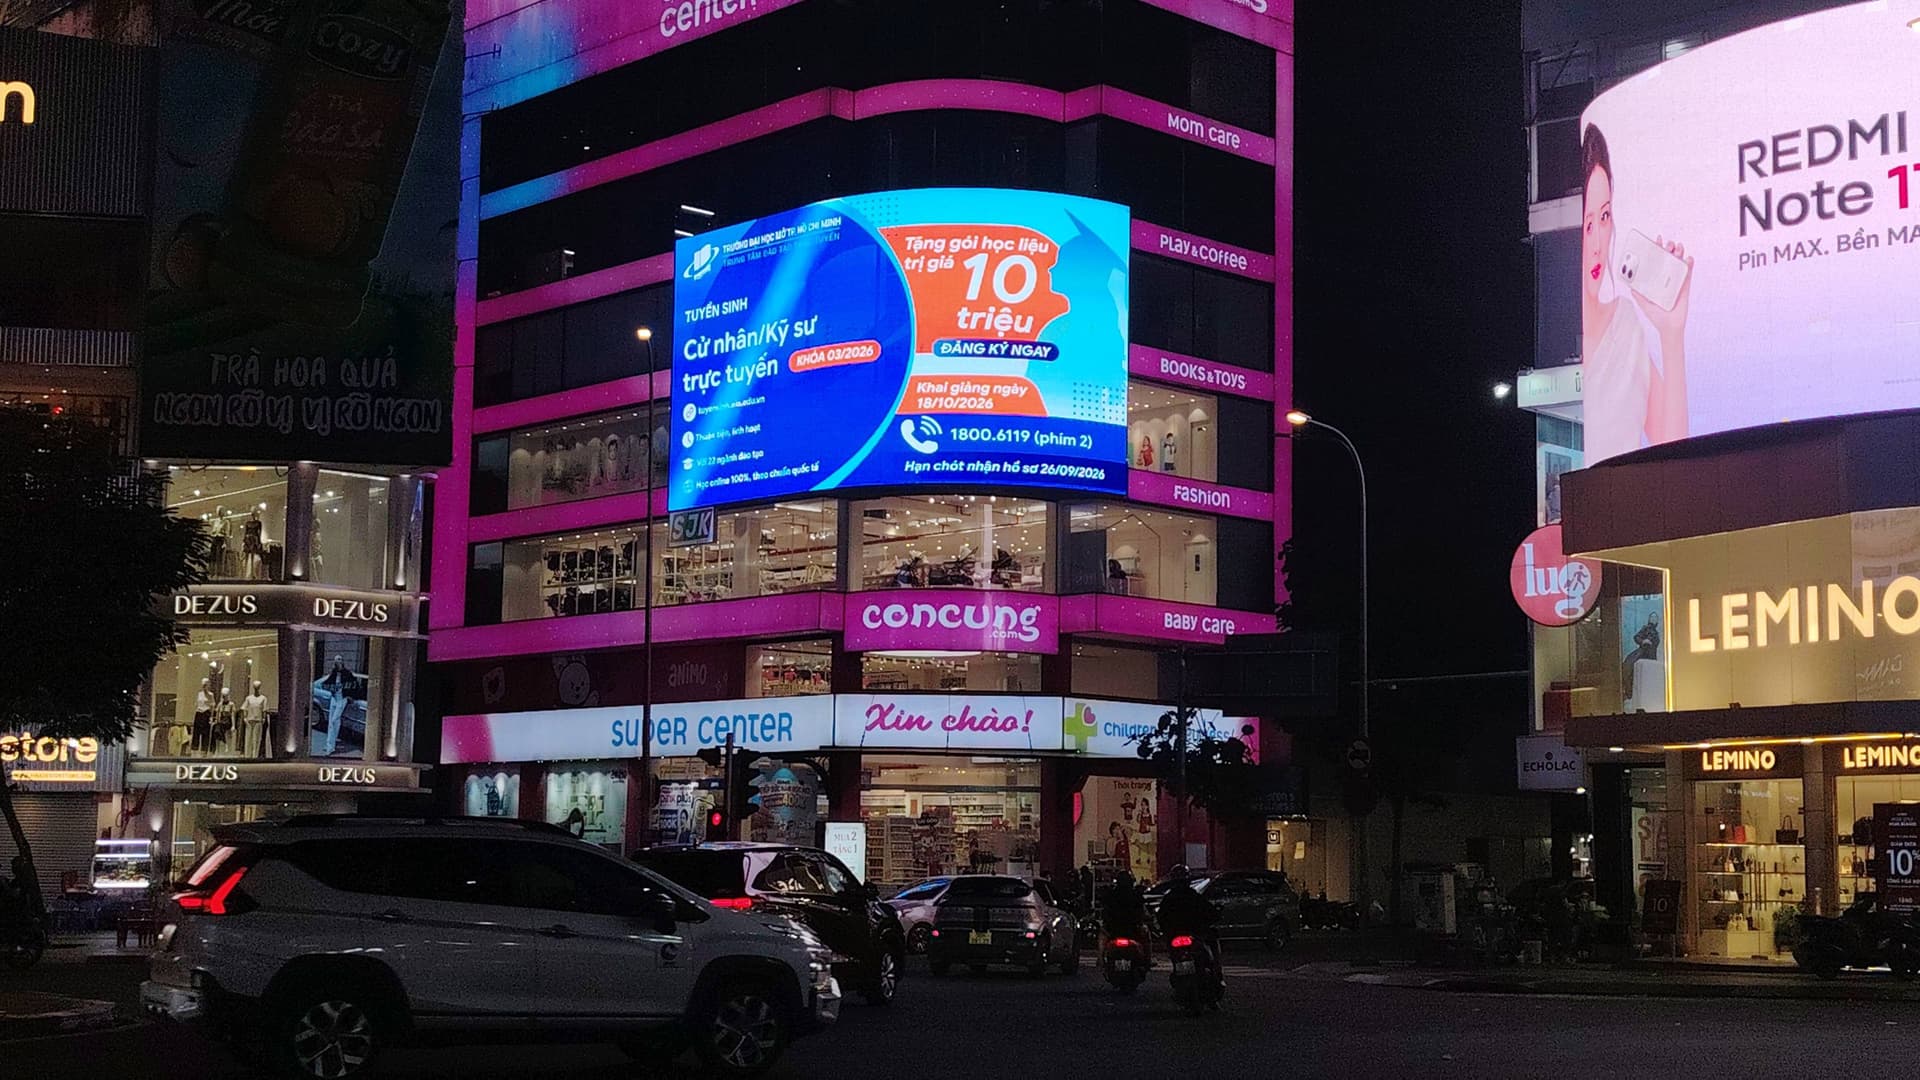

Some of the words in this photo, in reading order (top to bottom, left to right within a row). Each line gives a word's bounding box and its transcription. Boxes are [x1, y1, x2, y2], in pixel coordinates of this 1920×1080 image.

[1167, 112, 1204, 138] Mom
[1208, 125, 1241, 148] care
[1737, 111, 1908, 184] REDMI
[1738, 179, 1874, 237] Note
[1887, 163, 1920, 210] 1
[904, 236, 946, 254] Tặng
[981, 236, 1015, 254] học
[1018, 238, 1050, 256] liệu
[1738, 252, 1767, 271] Pin
[1773, 238, 1829, 265] MAX.
[1836, 227, 1880, 253] Bền
[904, 255, 925, 273] trị
[927, 255, 955, 273] giá
[963, 252, 1038, 304] 10
[721, 296, 749, 315] SINH
[957, 306, 1034, 338] triệu
[683, 335, 711, 361] Cử
[713, 318, 790, 355] nhân/Kỹ
[794, 314, 819, 338] sư
[1011, 344, 1052, 358] NGAY
[209, 346, 261, 386] TRÀ
[273, 355, 328, 388] HOA
[339, 344, 398, 388] QUẢ
[826, 344, 874, 362] 03/2026
[682, 367, 721, 395] trực
[726, 352, 778, 386] tuyến
[916, 381, 947, 394] Khai
[950, 383, 992, 397] giảng
[993, 384, 1029, 398] ngày
[917, 397, 994, 410] 18/10/2026
[950, 428, 1031, 443] 1800.6119
[1034, 430, 1077, 447] (phím
[1079, 434, 1093, 449] 2)
[904, 460, 931, 474] Hạn
[932, 460, 965, 473] chót
[966, 460, 1001, 474] nhận
[1002, 460, 1021, 473] hồ
[1022, 463, 1039, 475] sơ
[1040, 464, 1105, 480] 26/09/2026
[1174, 485, 1231, 508] Fashion
[671, 511, 712, 540] SJK
[174, 595, 258, 615] DEZUS
[314, 598, 388, 622] DEZUS
[862, 603, 1041, 642] concung
[1689, 575, 1920, 653] LEMINO
[1202, 616, 1236, 635] care
[865, 702, 933, 732] Xin
[940, 704, 1034, 733] chào!
[1523, 760, 1576, 772] ECHOLAC
[1702, 749, 1776, 772] LEMINO
[1843, 744, 1920, 769] LEMINO
[175, 764, 238, 781] DEZUS
[318, 767, 376, 784] DEZUS
